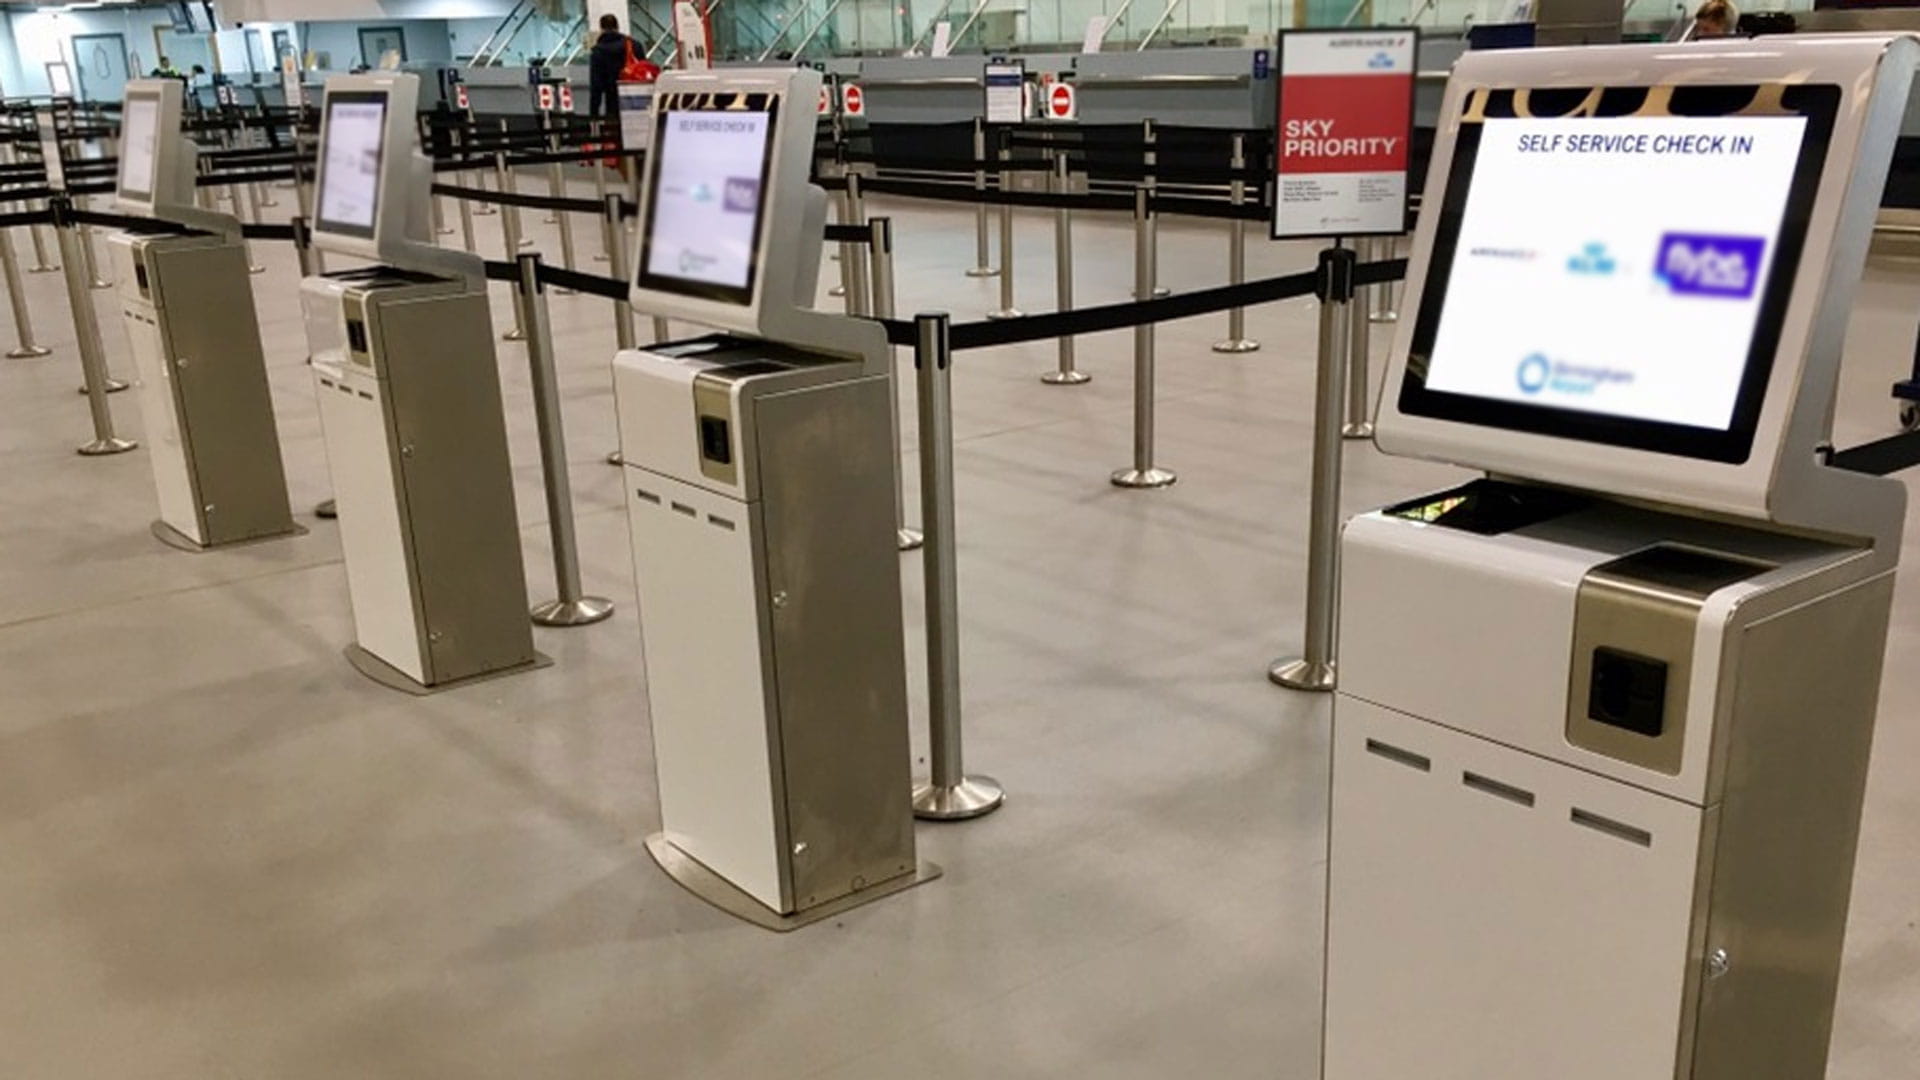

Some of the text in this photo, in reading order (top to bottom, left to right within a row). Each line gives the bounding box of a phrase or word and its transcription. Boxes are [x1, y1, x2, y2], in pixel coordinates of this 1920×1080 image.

[1285, 119, 1334, 138] SKY
[1284, 137, 1397, 157] PRIORITY
[1517, 134, 1755, 155] SELF SERVICE CHECK IN
